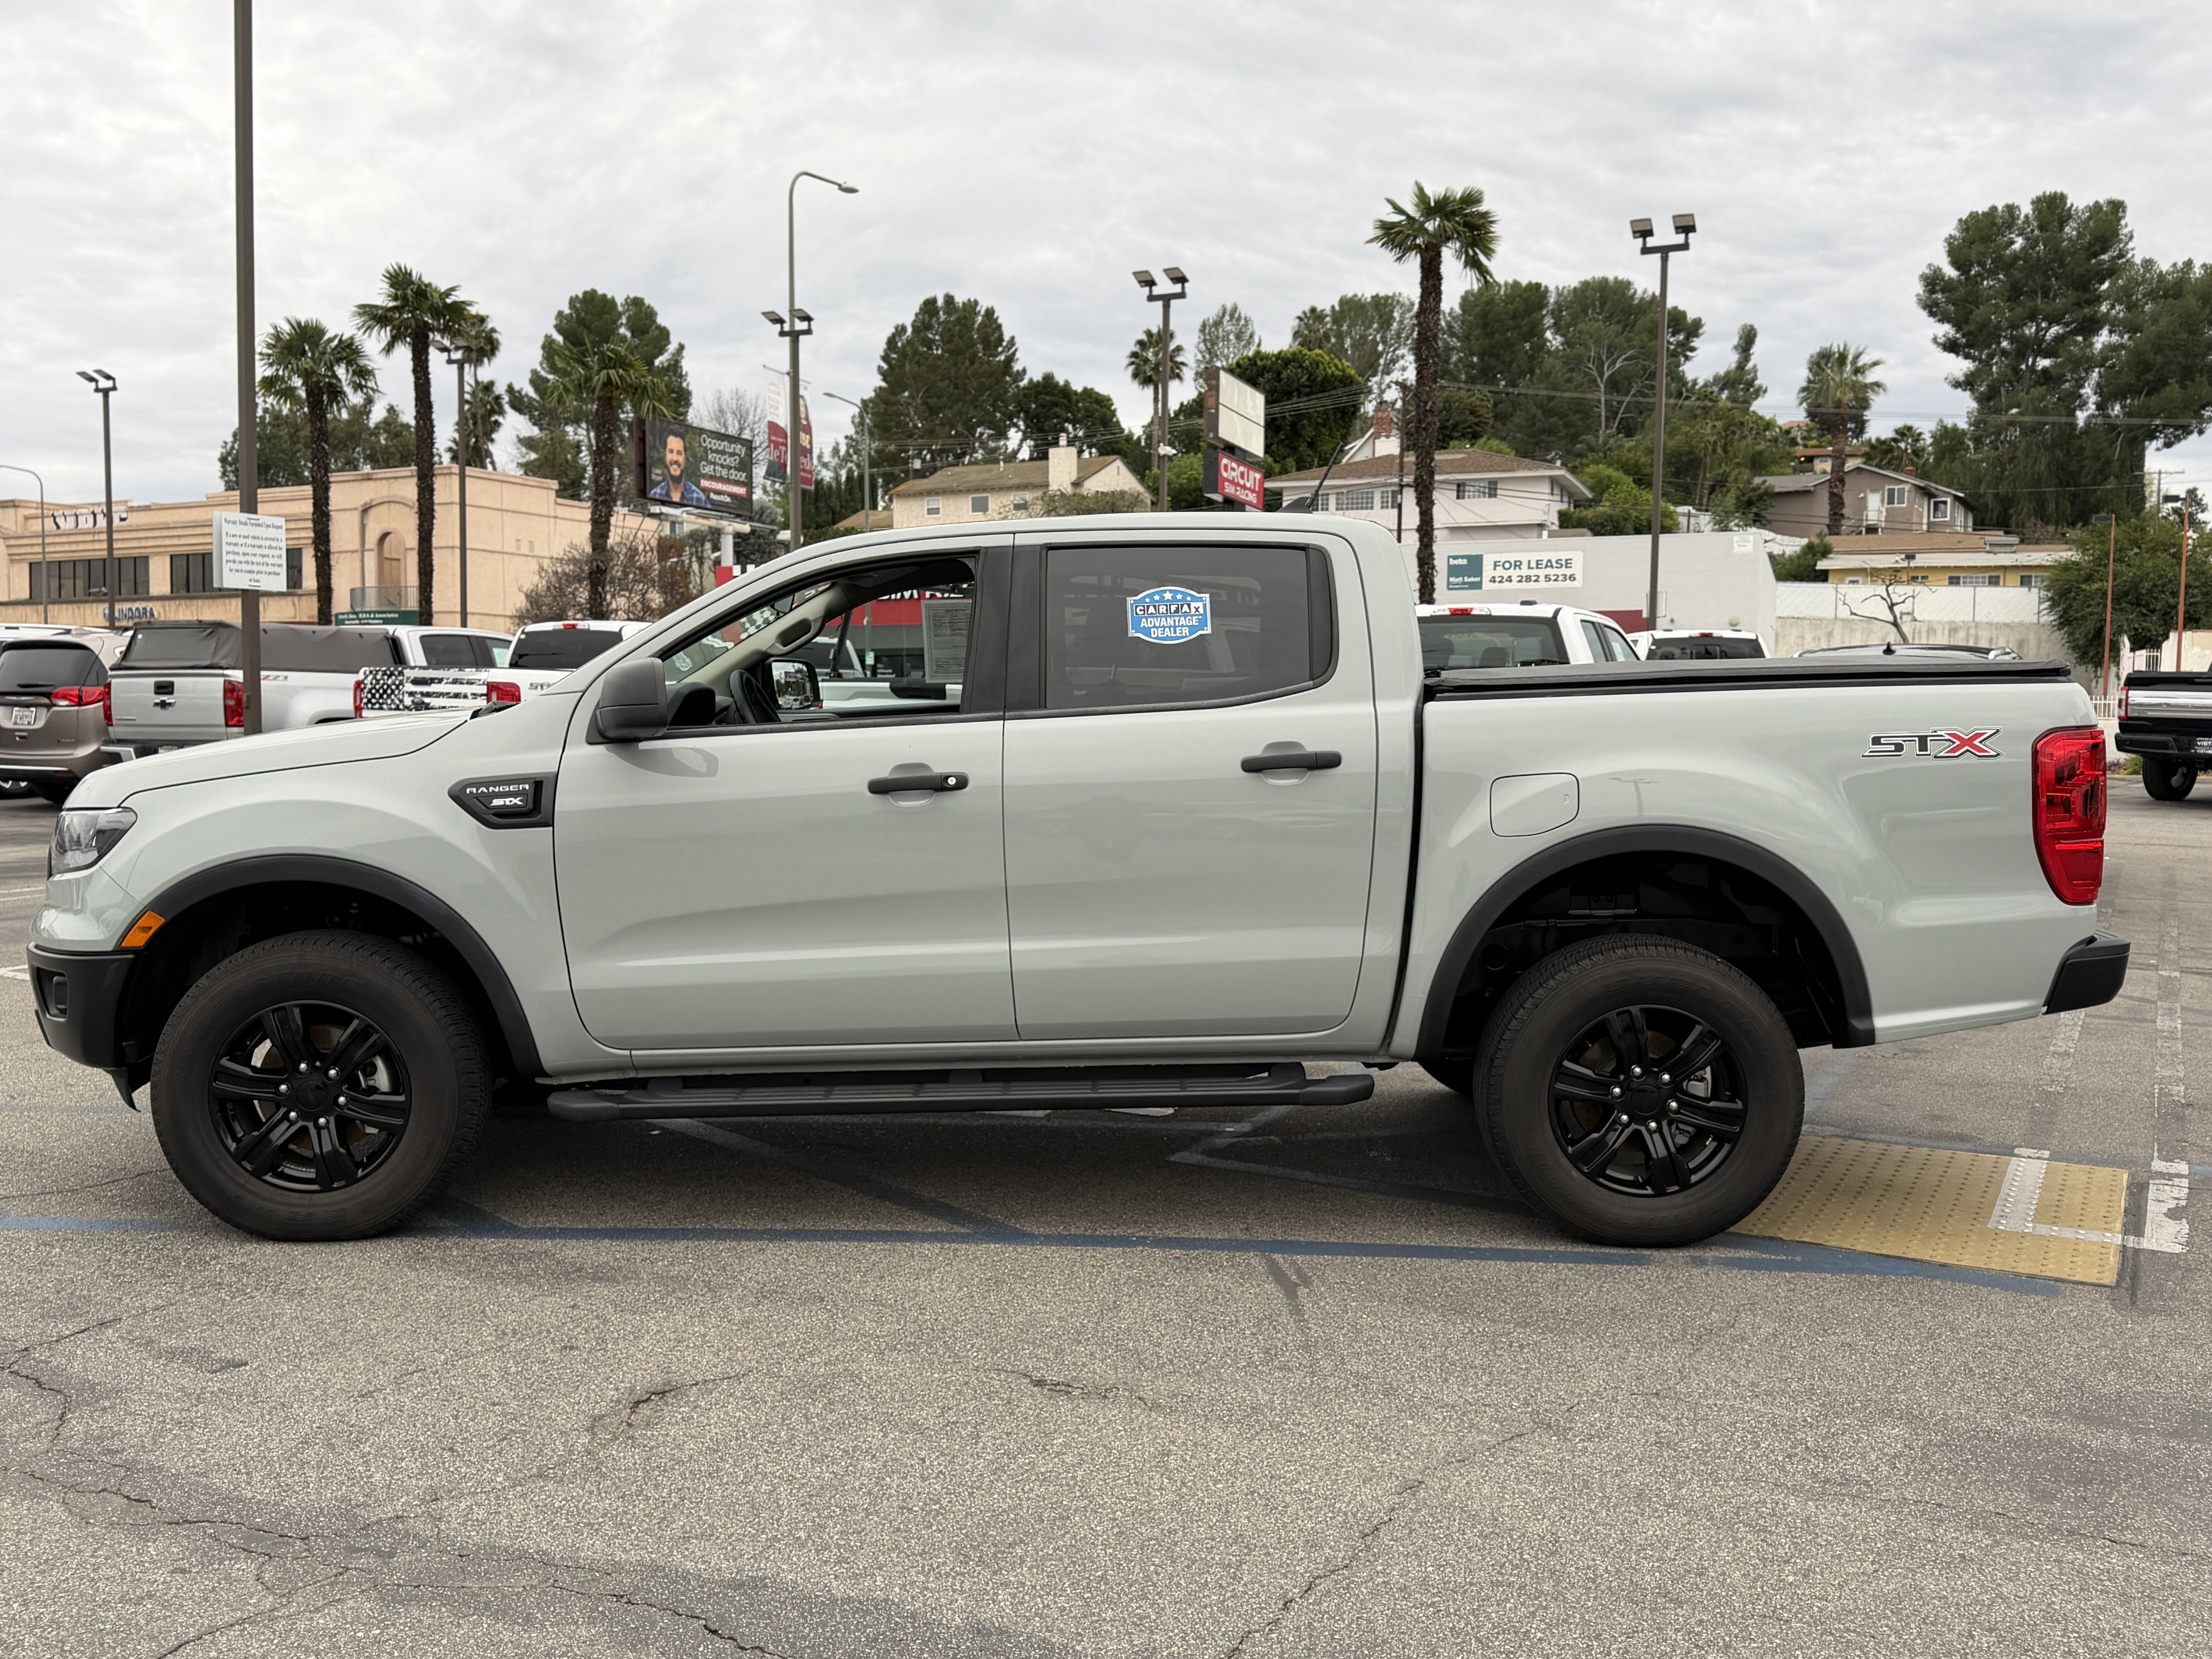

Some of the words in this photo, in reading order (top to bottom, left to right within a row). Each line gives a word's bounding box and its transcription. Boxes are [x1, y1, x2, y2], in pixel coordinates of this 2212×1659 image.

[701, 434, 746, 457] Opportunity
[708, 450, 740, 467] knocks?
[700, 461, 714, 476] Get
[715, 465, 728, 478] the
[1221, 458, 1261, 491] CIRCUIT
[1493, 560, 1522, 571] FOR
[1527, 558, 1573, 570] LEASE
[1489, 575, 1512, 584] 424
[1516, 574, 1540, 583] 282
[1544, 574, 1576, 582] 5236
[1135, 603, 1201, 615] CARFAX
[1151, 627, 1189, 638] DEALER
[1862, 726, 2005, 761] STX
[466, 784, 529, 793] RANGER
[490, 797, 524, 806] STX
